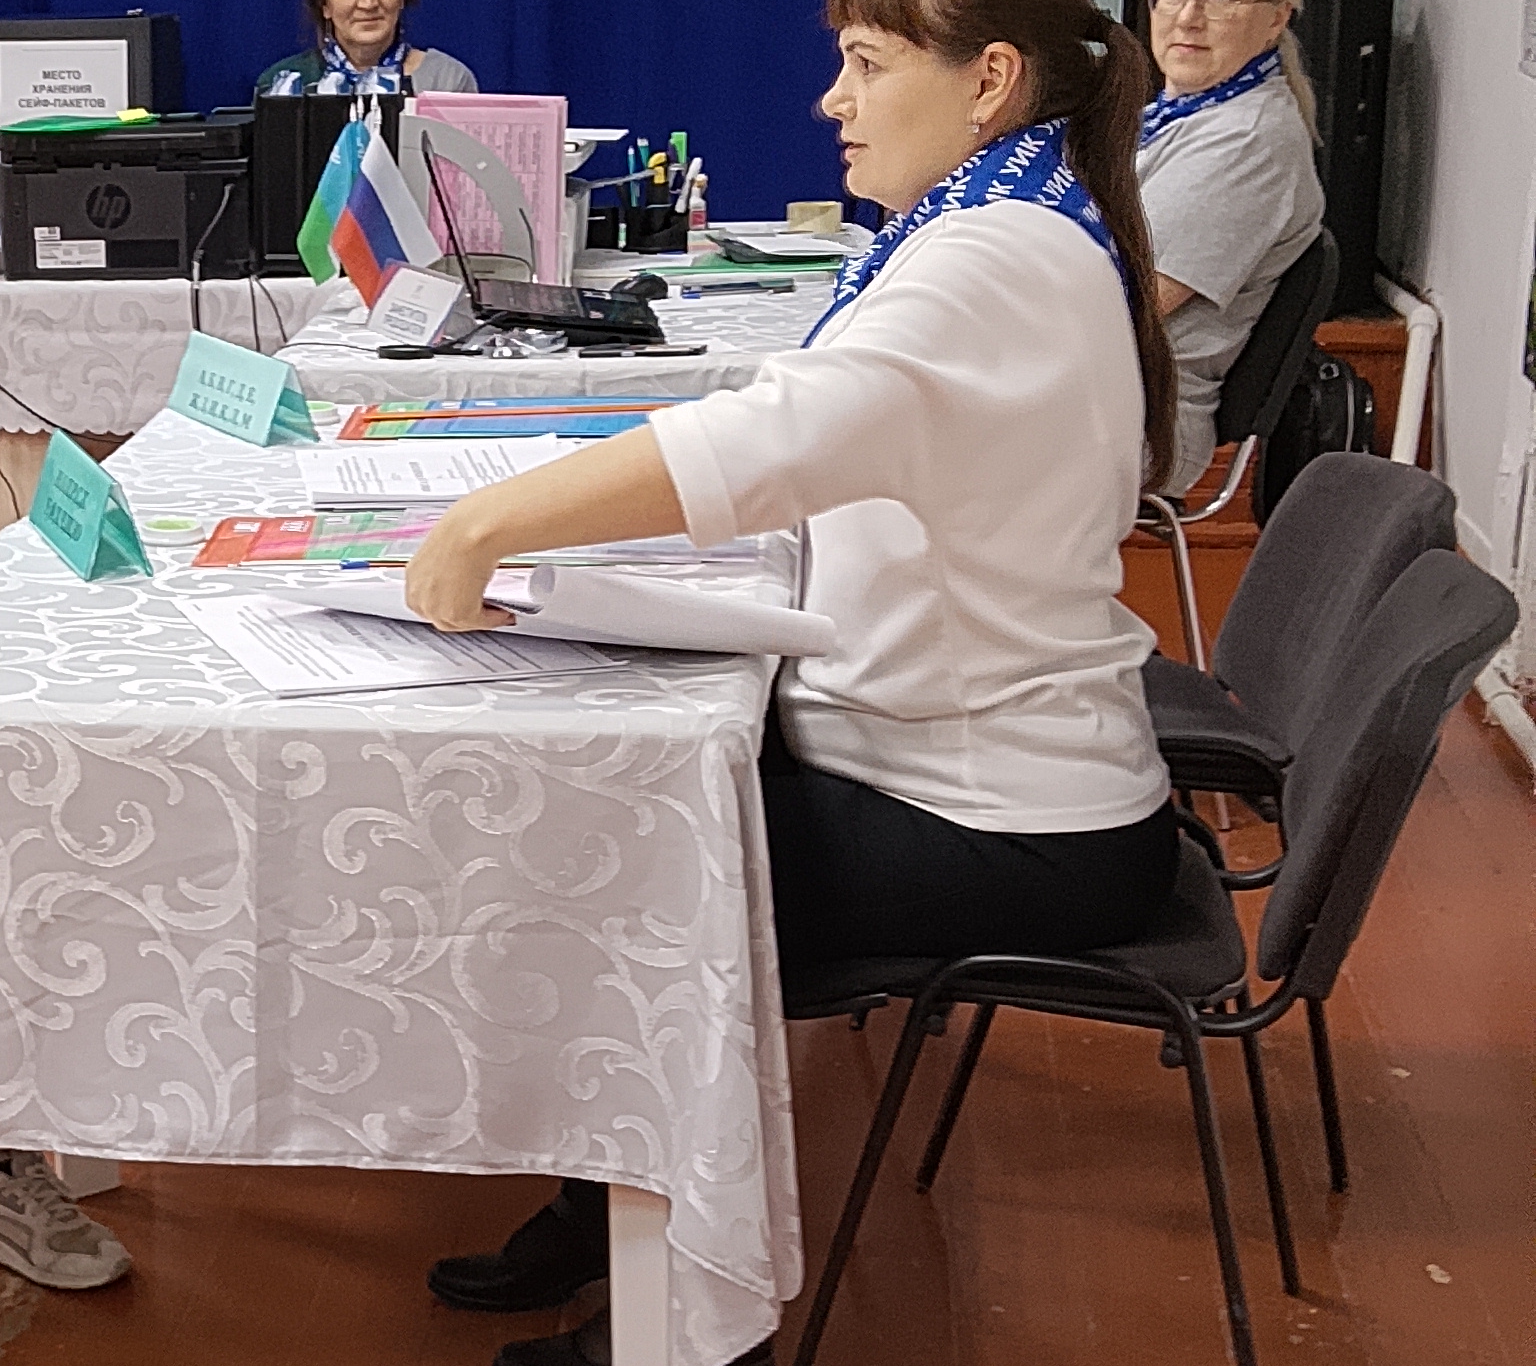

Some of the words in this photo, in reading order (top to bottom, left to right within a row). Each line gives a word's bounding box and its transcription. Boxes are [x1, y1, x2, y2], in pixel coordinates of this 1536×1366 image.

[41, 70, 82, 81] МЕСТО
[31, 84, 93, 94] ХРАНЕНИЯ
[17, 96, 107, 109] СЕЙФ-ПАКЕТОВ
[999, 132, 1046, 178] УИК
[90, 183, 128, 230] hp
